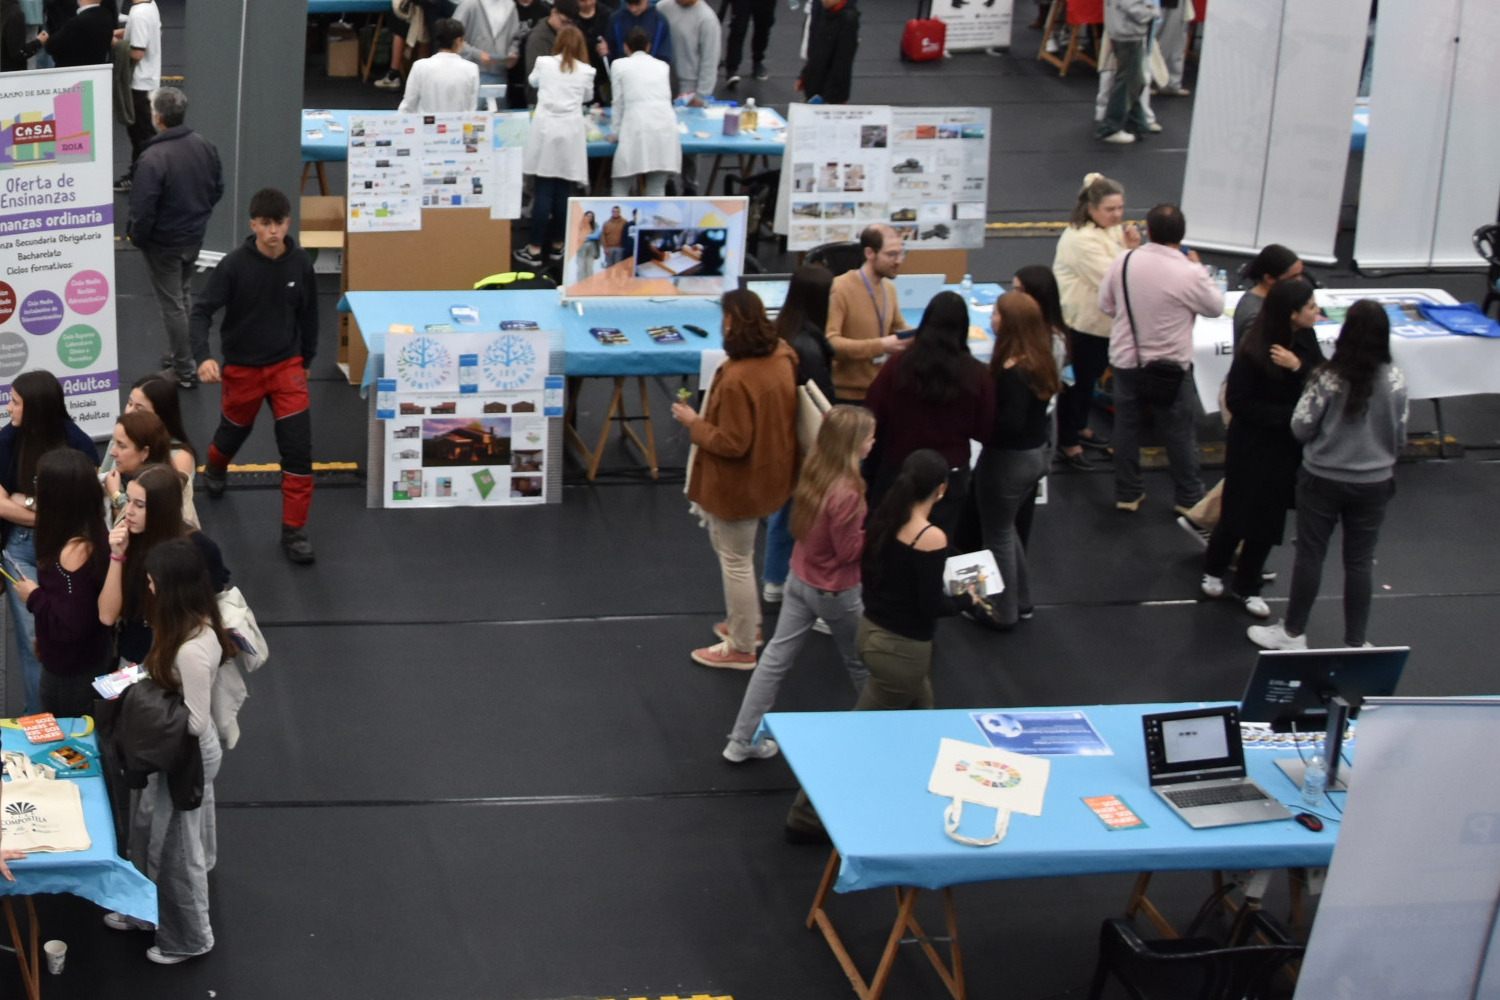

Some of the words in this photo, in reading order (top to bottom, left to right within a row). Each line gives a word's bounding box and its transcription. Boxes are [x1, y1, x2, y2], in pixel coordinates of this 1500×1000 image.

[53, 86, 85, 94] ALBERTO
[6, 175, 52, 193] Oferta
[57, 173, 74, 187] de
[0, 191, 76, 209] Ensinanzas
[46, 210, 103, 227] ordinaria
[15, 236, 56, 248] Secundaria
[59, 232, 101, 244] Obrigatoria
[18, 250, 61, 261] Bacharelato
[7, 266, 28, 275] Ciclos
[63, 377, 111, 394] Adultos
[70, 399, 97, 409] Iniciais
[79, 411, 110, 422] Adultos
